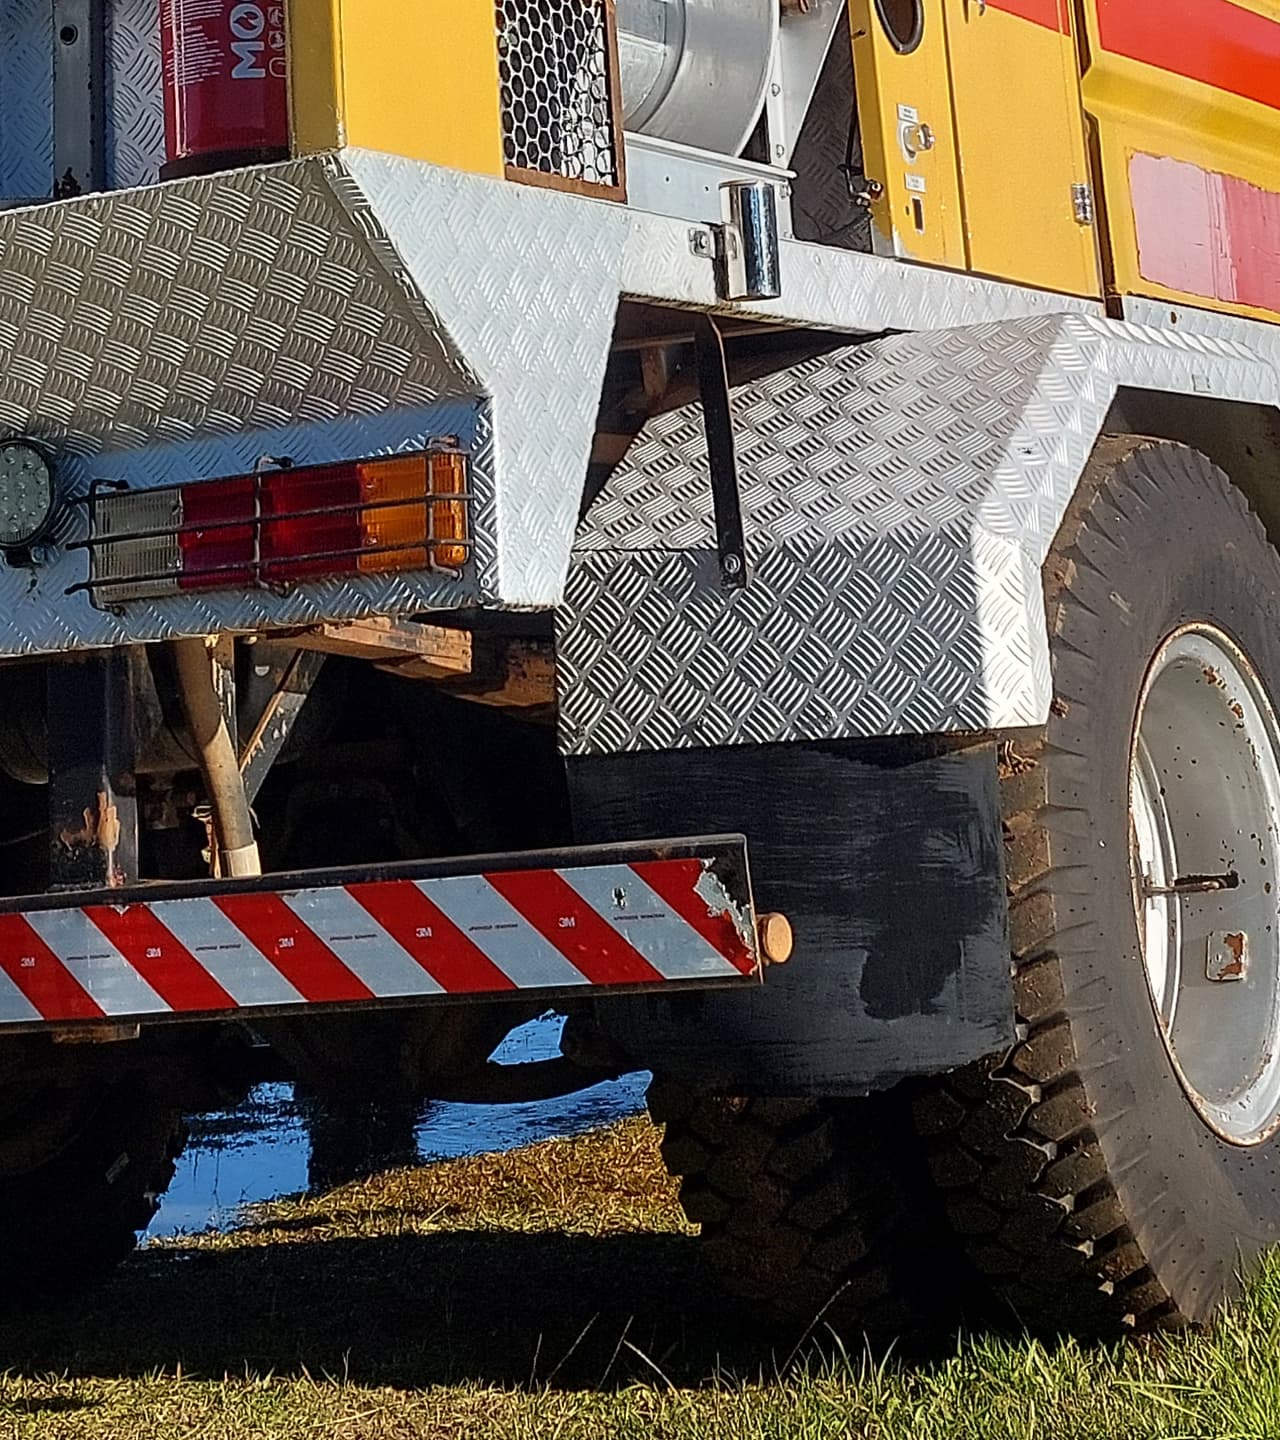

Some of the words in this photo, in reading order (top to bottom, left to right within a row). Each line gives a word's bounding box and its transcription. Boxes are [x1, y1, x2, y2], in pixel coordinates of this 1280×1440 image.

[558, 916, 576, 929] 3M
[416, 926, 432, 938] 3M
[278, 937, 295, 948] 3M
[145, 947, 162, 958] 3M
[20, 957, 36, 968] 3M
